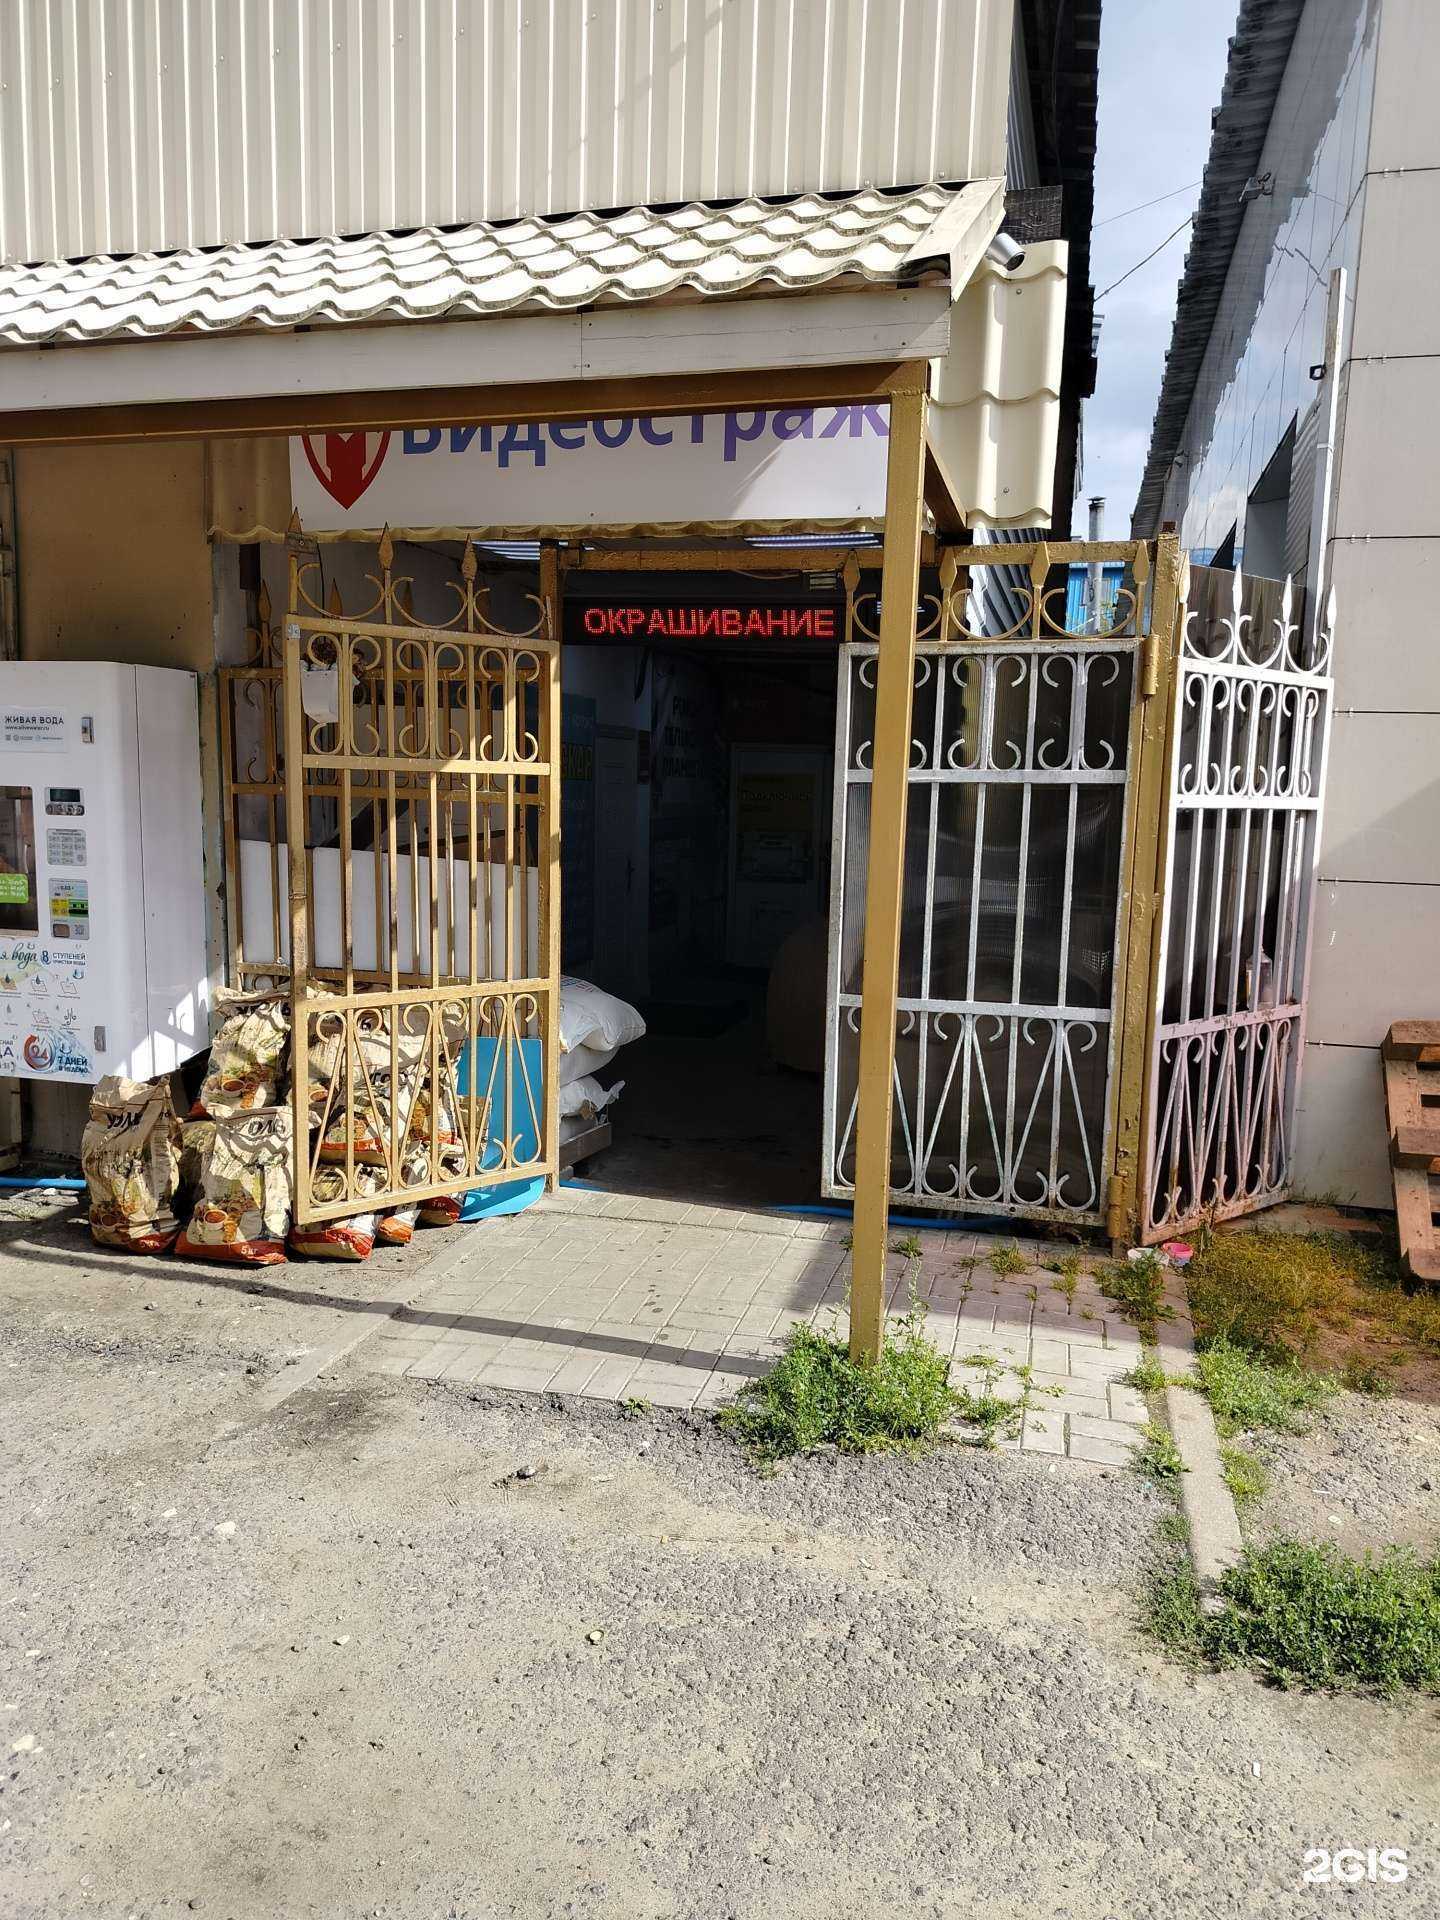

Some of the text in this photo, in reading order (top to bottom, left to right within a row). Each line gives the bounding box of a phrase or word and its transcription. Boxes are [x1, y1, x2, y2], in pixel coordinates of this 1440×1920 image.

[584, 608, 833, 637] ОКРАШИВАНИЕ
[5, 715, 64, 726] ЖИВАЯ ВОДА
[52, 952, 86, 961] СТУПЕНЕЙ
[65, 1056, 88, 1066] ДНЕЙ
